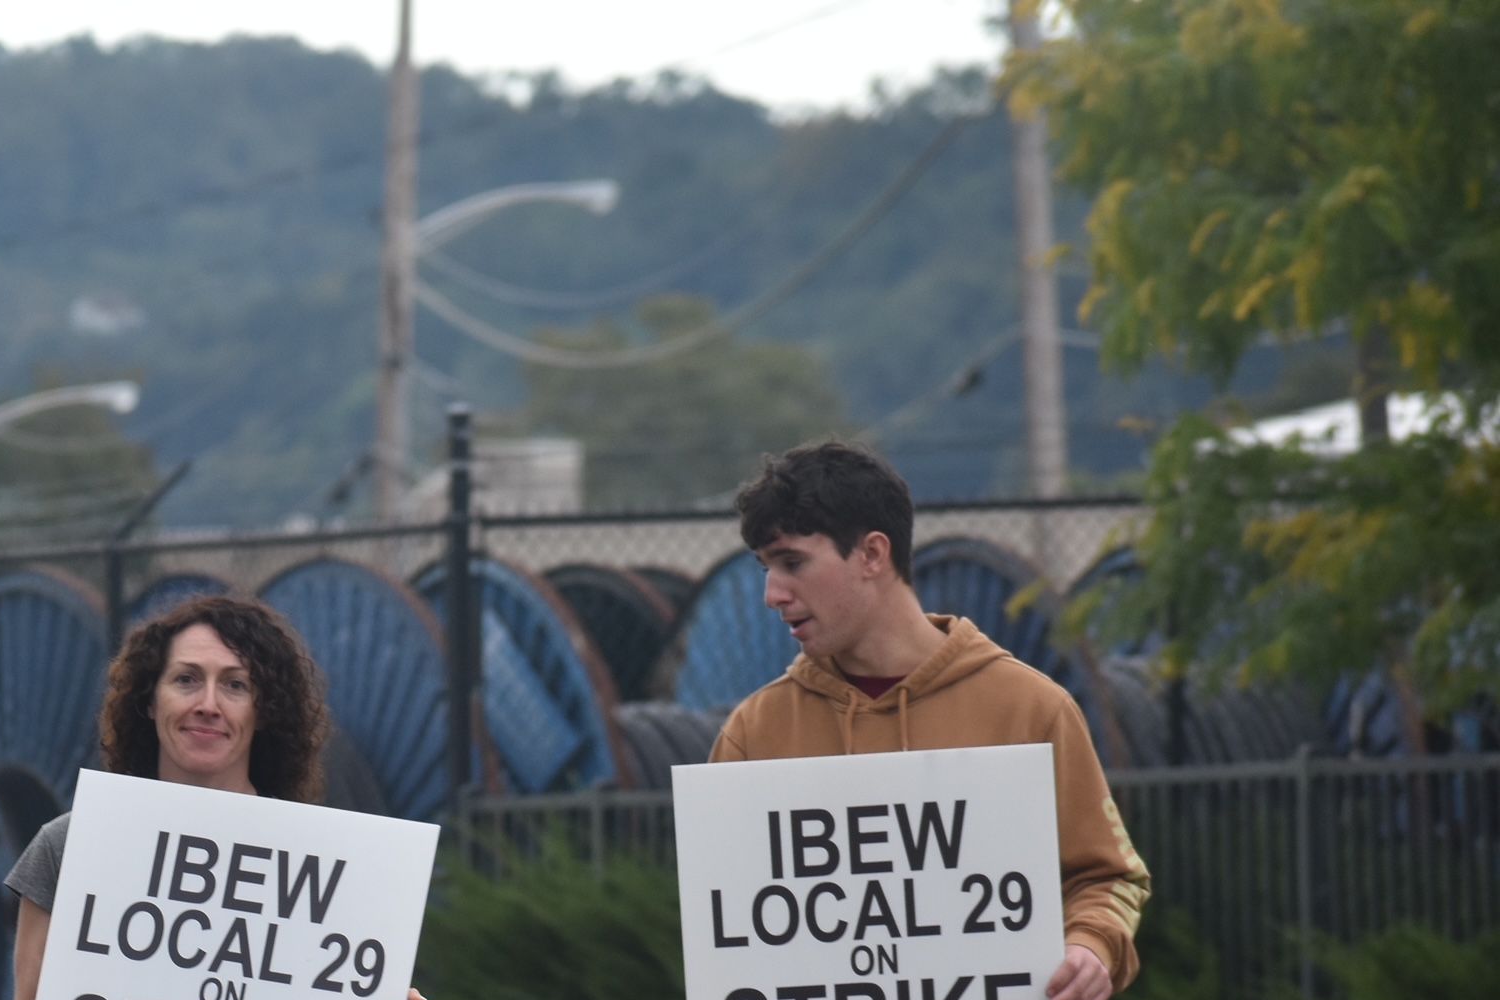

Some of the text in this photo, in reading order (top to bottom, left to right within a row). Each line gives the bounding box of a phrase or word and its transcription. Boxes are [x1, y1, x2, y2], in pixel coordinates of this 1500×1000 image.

[147, 830, 347, 925] IBEW
[767, 799, 967, 880] IBEW
[76, 893, 385, 998] LOCAL 29
[710, 871, 1033, 949] LOCAL 29
[850, 943, 899, 977] ON
